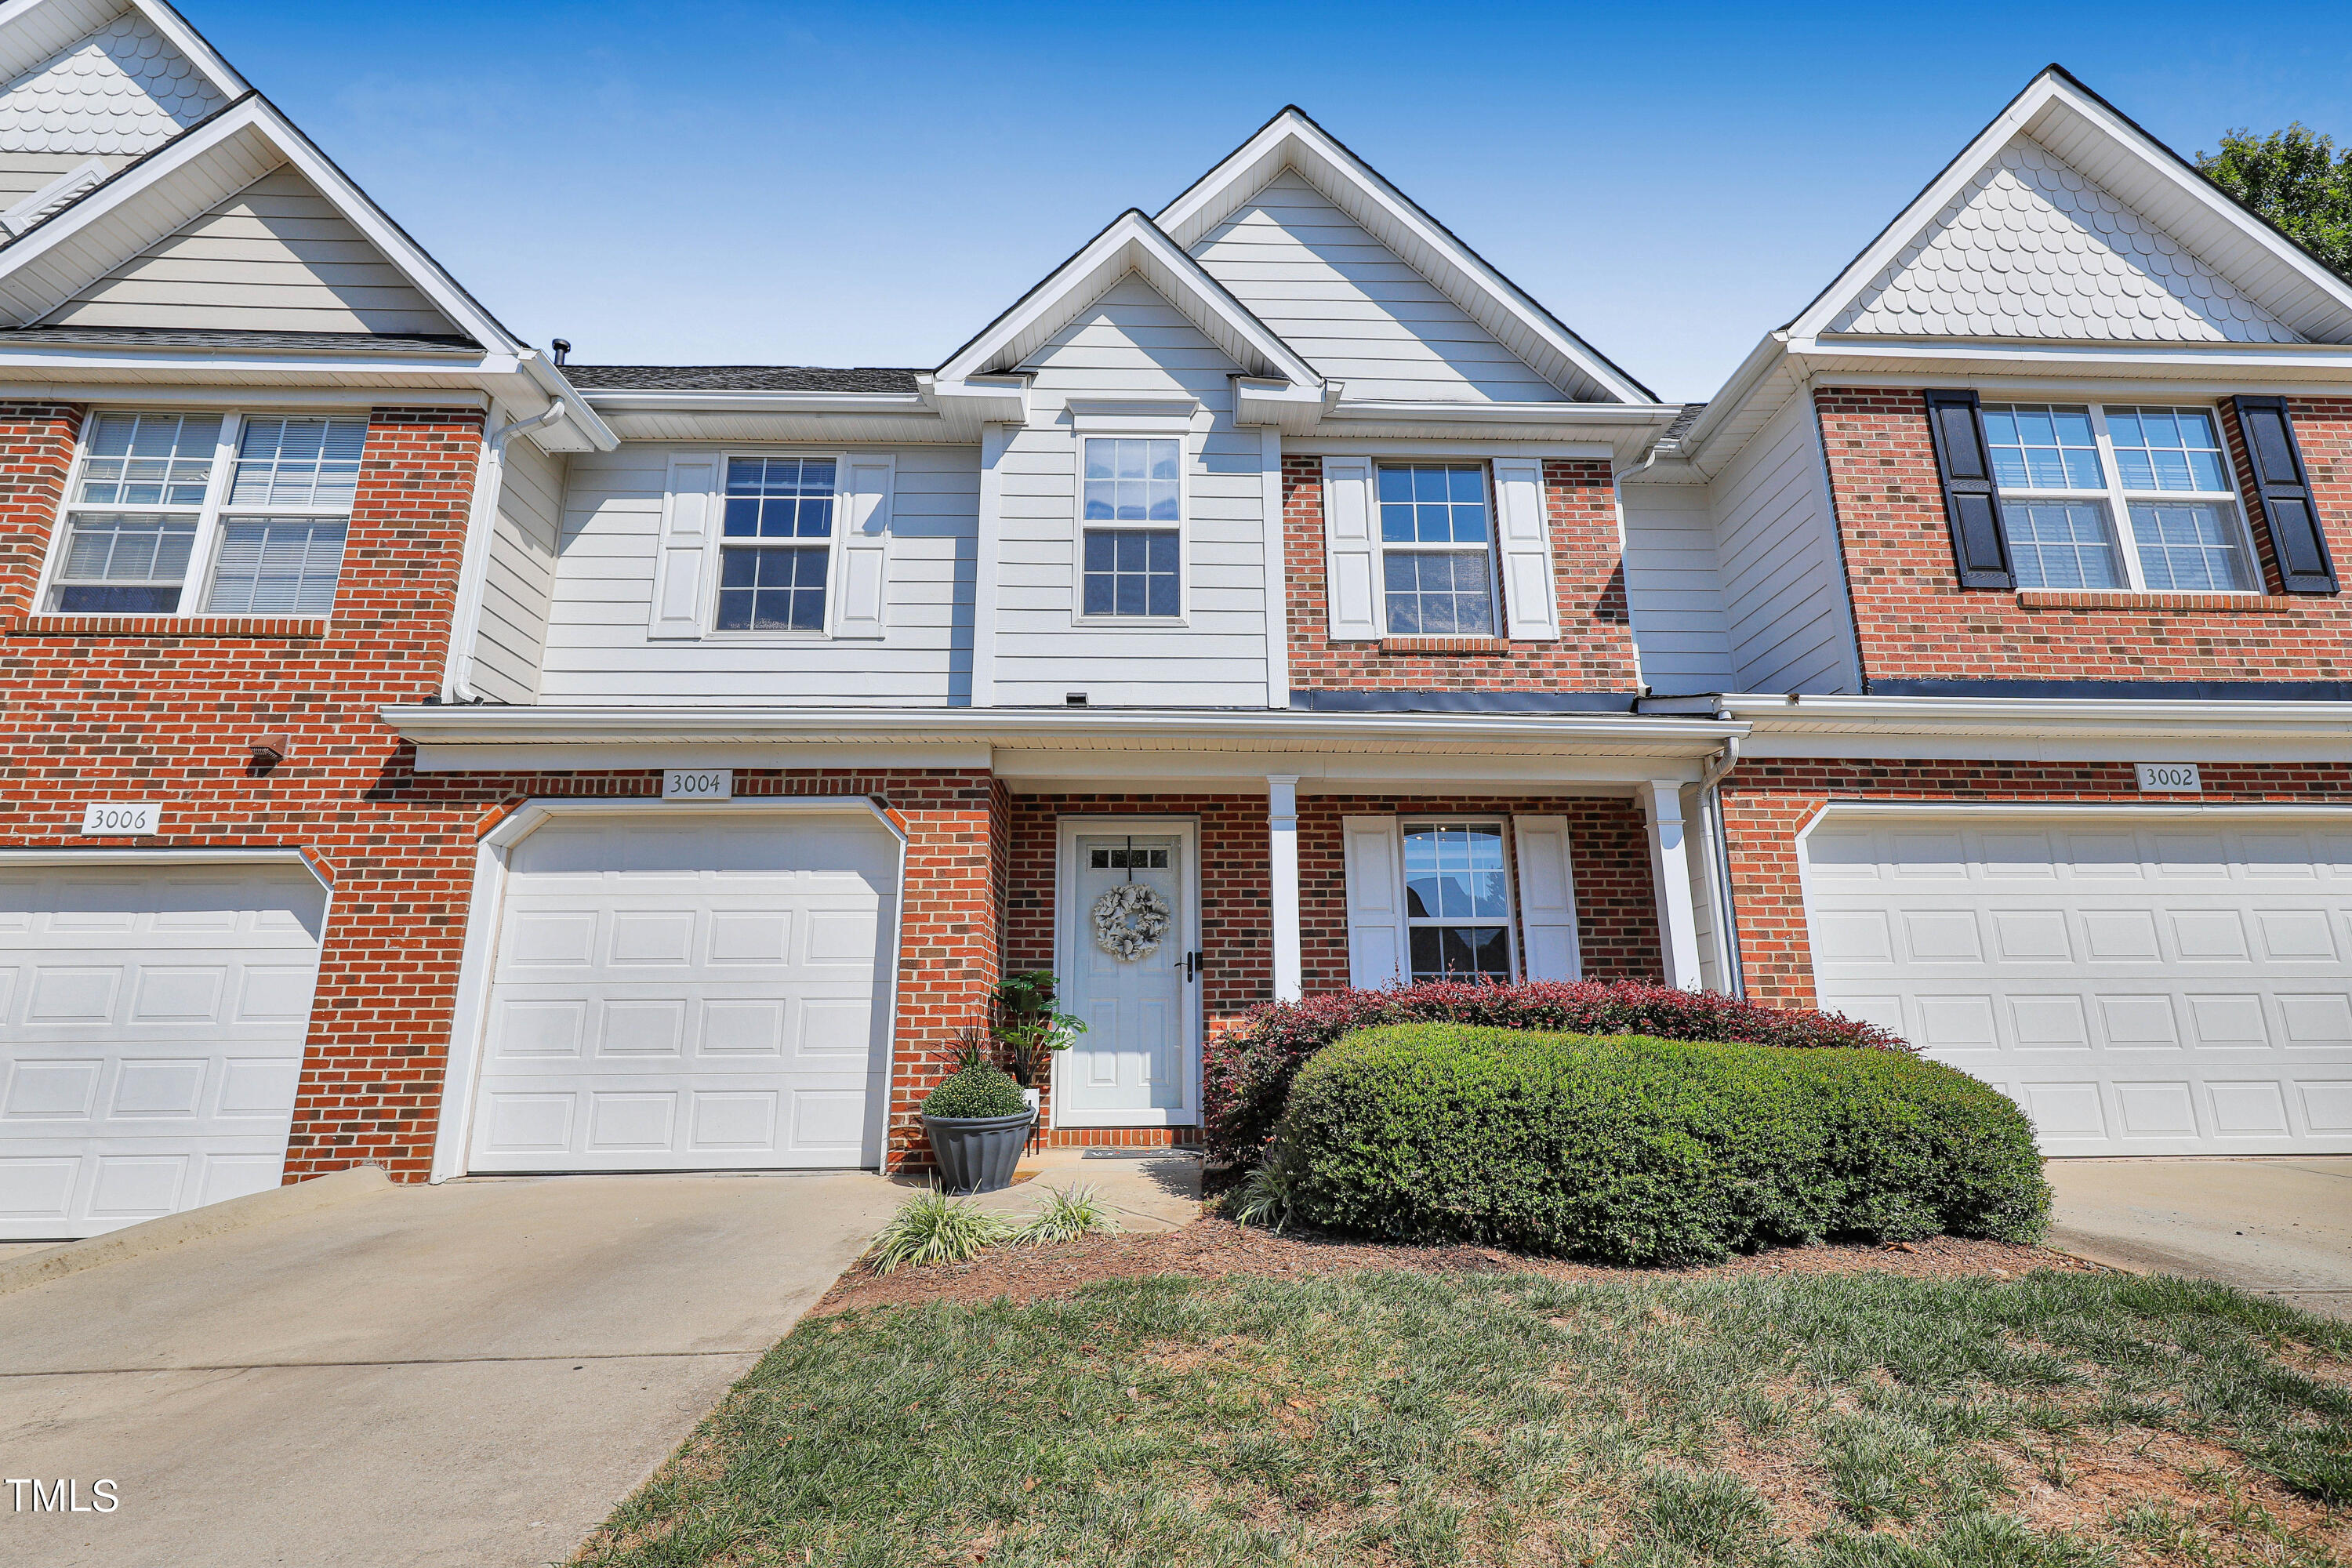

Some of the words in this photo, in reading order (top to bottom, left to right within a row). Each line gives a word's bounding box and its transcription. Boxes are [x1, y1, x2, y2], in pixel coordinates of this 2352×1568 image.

[670, 774, 720, 793] 3004
[2147, 768, 2193, 786] 3002
[91, 810, 146, 829] 3006
